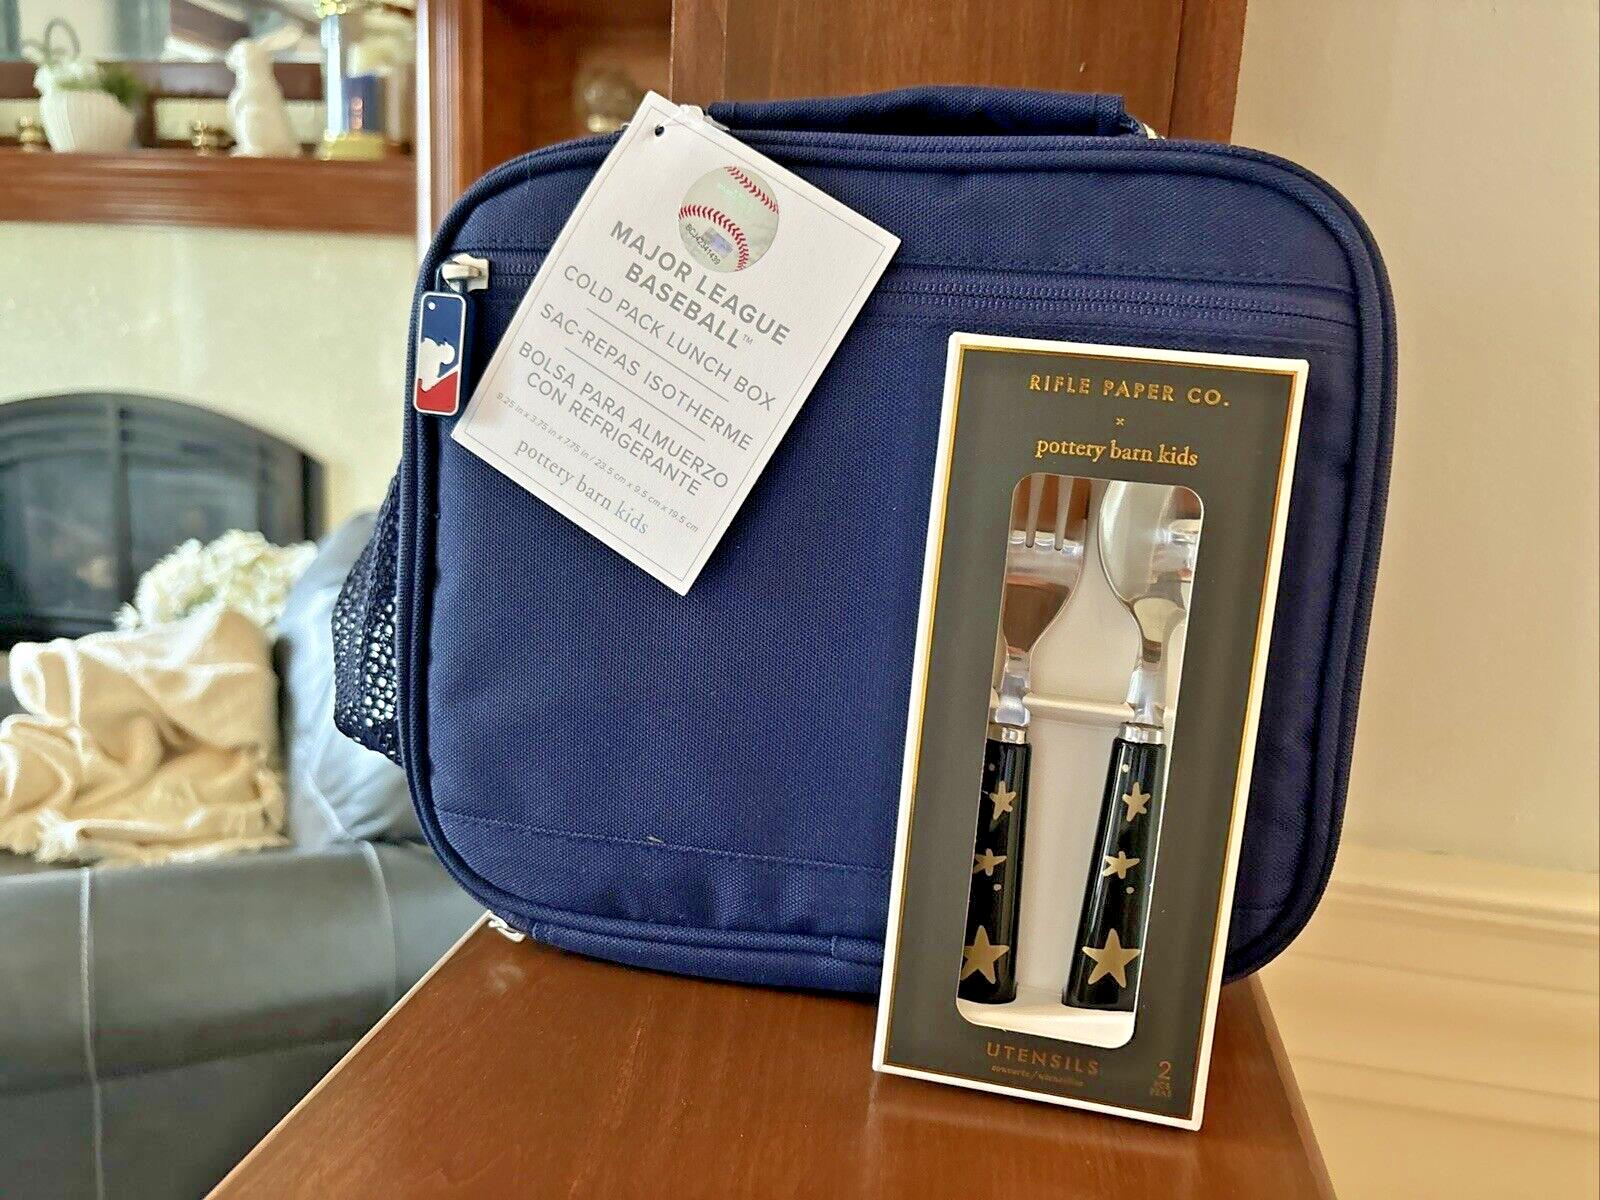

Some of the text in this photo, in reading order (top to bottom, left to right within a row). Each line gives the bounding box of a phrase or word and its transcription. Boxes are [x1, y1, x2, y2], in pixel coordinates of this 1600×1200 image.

[563, 264, 776, 411] COLD PACK LUNCH BOX
[609, 219, 790, 345] MAJOR LEAGUE
[518, 340, 728, 488] BOLSA PARA ALMUERZO
[526, 371, 702, 496] CON REFRIGERANTE
[539, 302, 753, 451] SAC-REPAS ISOTHERME
[1029, 373, 1230, 407] RIFLE PAPER CO.
[495, 391, 516, 408] 9.25
[529, 414, 549, 431] 3.75
[562, 436, 581, 453] 7.75
[593, 457, 615, 475] 23.5
[613, 472, 626, 484] cm
[632, 484, 648, 498] 9.5
[647, 495, 661, 507] cm
[667, 508, 687, 524] 19.5
[684, 520, 699, 533] cm
[513, 439, 648, 534] pottery barn kids
[1035, 438, 1199, 467] pottery barn kids
[986, 1041, 1099, 1075] UTENSILS
[1158, 1061, 1171, 1080] 2
